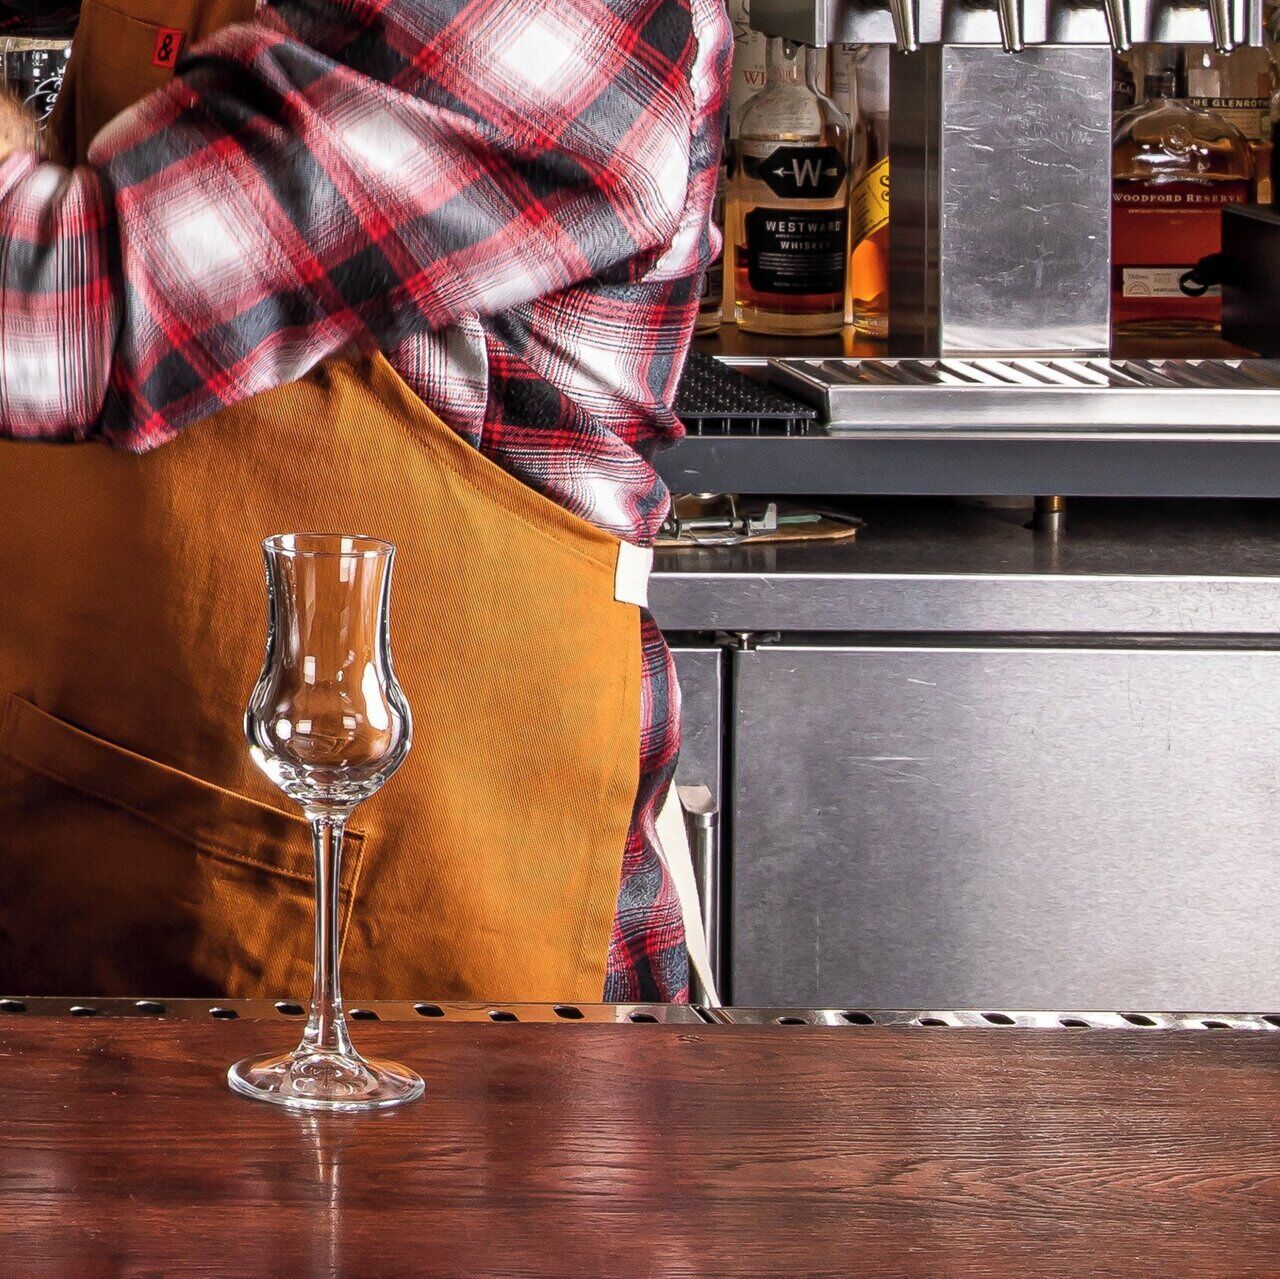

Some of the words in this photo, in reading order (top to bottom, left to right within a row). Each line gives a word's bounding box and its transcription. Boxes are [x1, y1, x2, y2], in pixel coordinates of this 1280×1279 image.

[1212, 99, 1269, 108] GLENROTH
[792, 158, 822, 188] W
[1111, 193, 1184, 204] WOODFORD
[765, 220, 842, 234] WESTWARD
